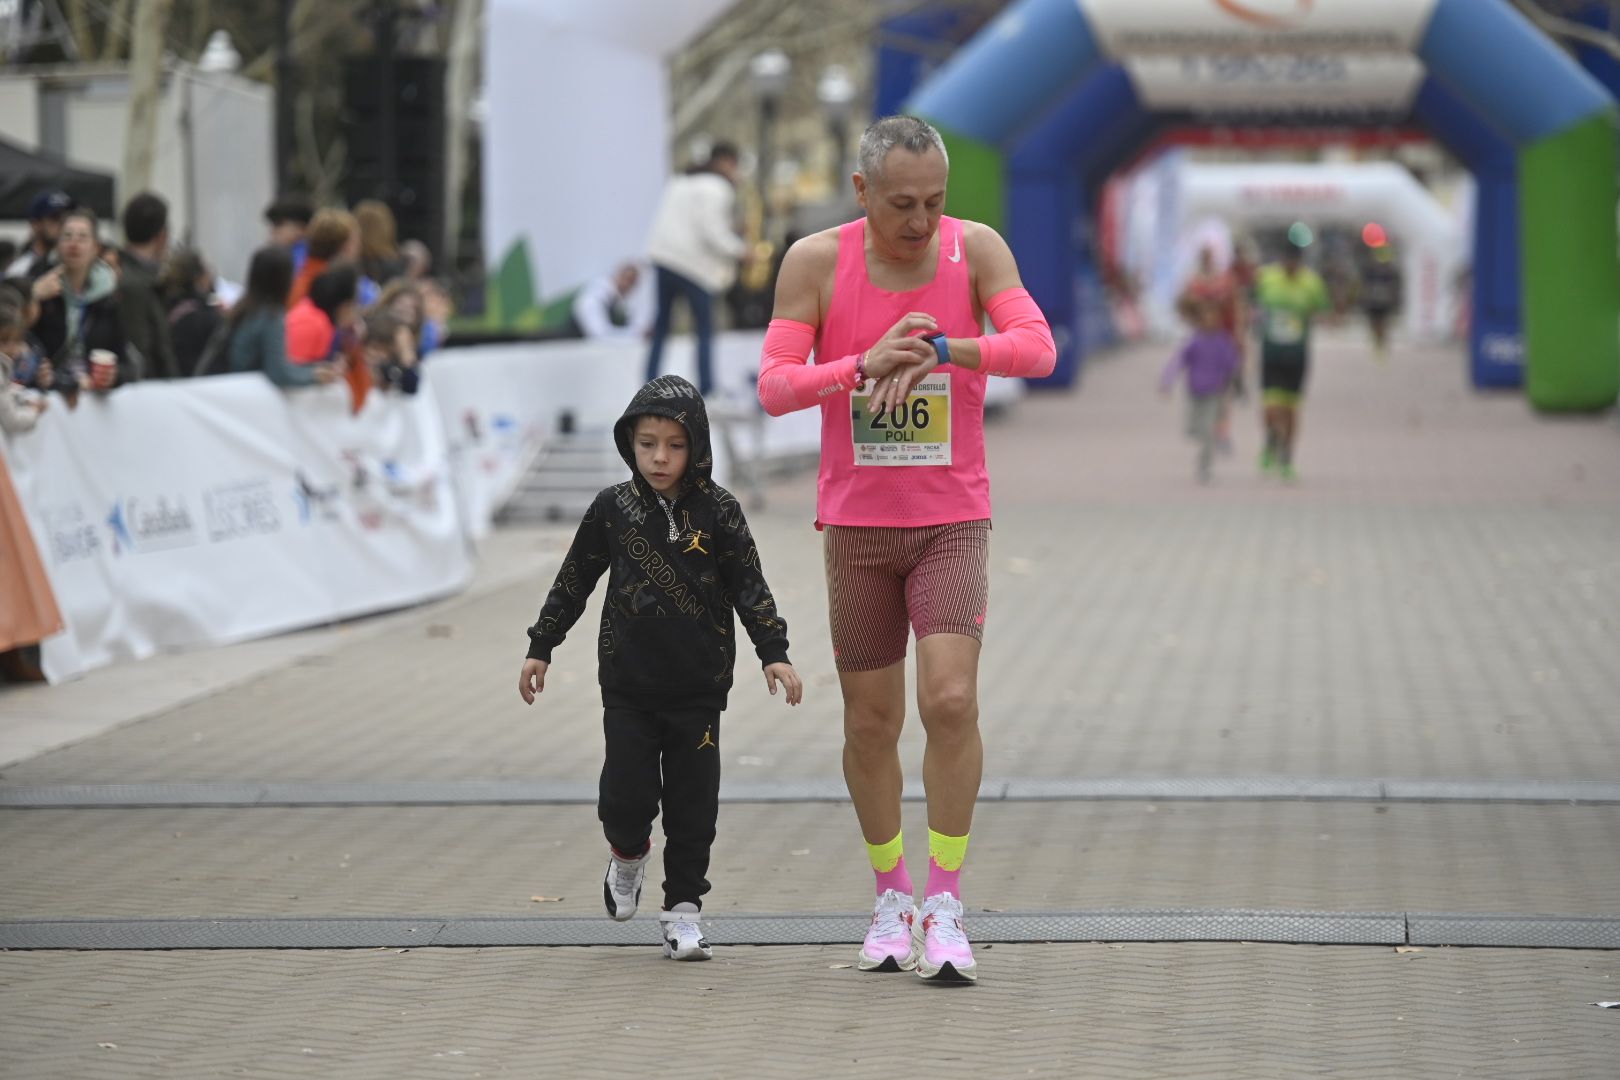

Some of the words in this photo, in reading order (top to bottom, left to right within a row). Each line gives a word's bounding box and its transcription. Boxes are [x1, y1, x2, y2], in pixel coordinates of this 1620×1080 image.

[870, 397, 929, 429] 206
[885, 430, 914, 442] POLI
[619, 527, 706, 618] JORDAN
